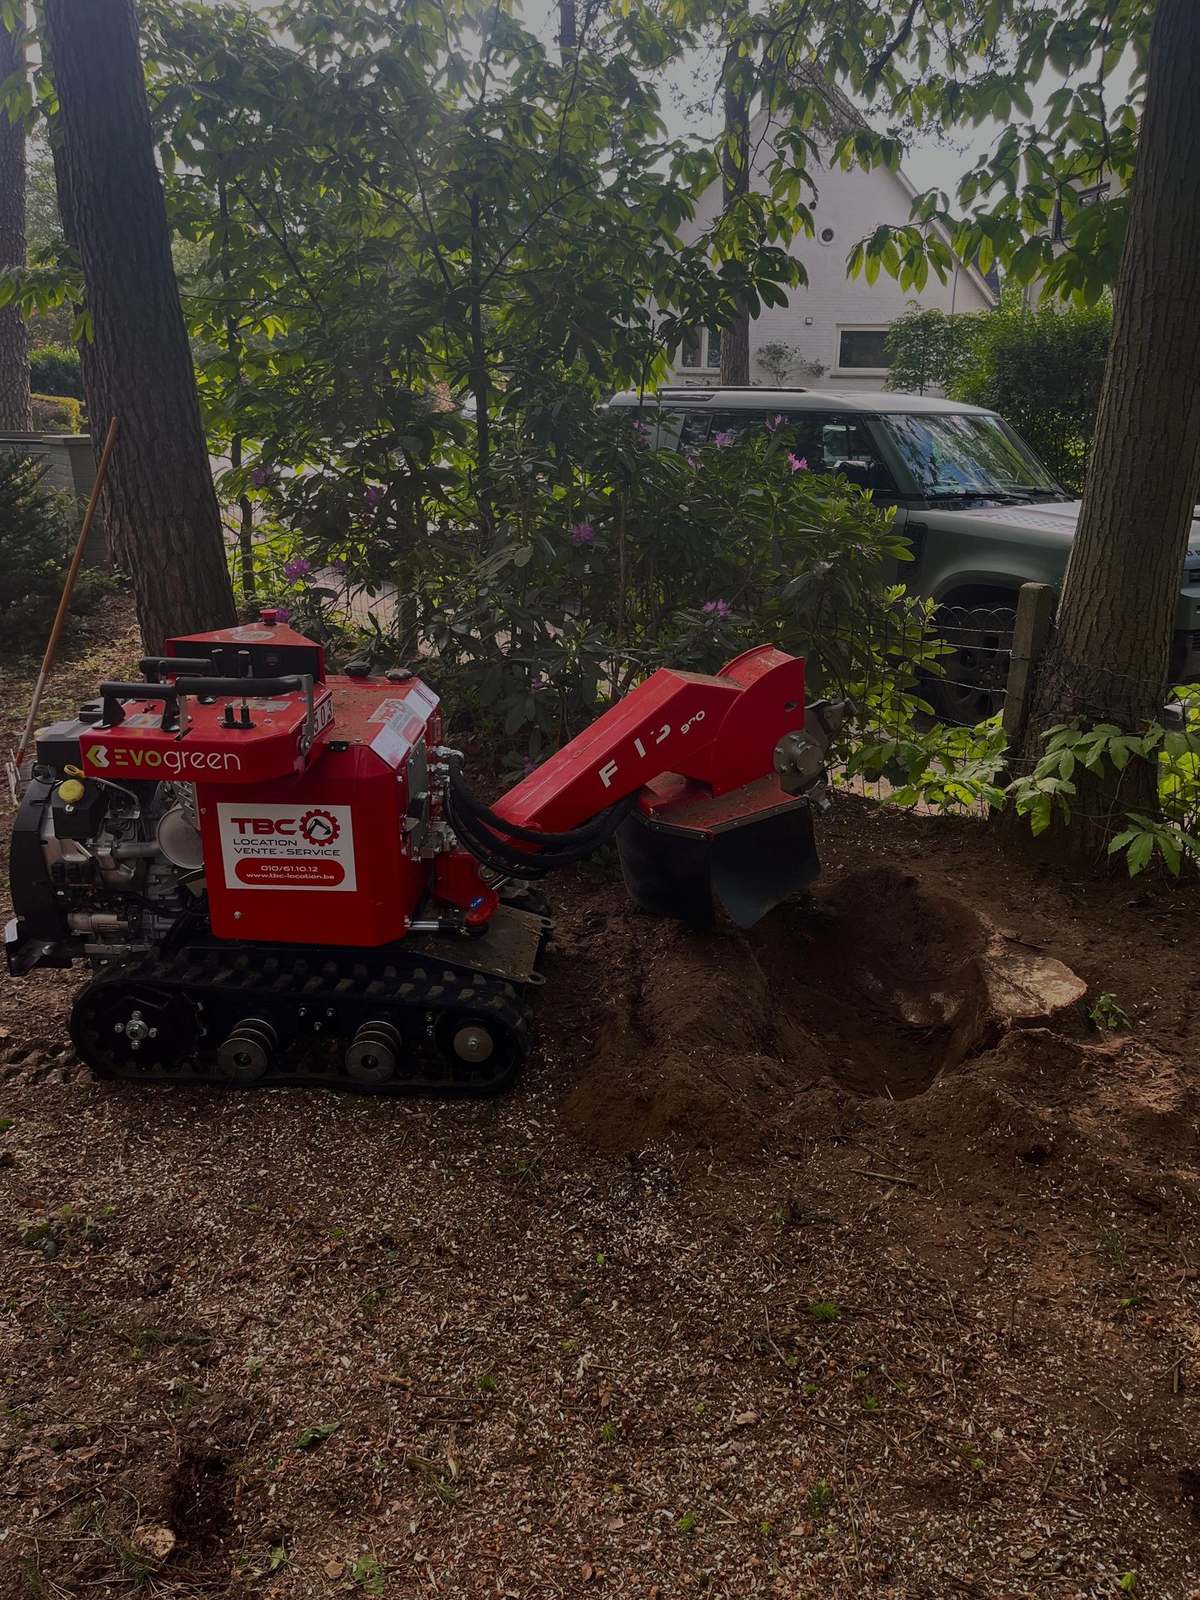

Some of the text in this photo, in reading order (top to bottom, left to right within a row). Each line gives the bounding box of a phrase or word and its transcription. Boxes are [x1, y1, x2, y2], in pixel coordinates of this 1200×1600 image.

[231, 818, 296, 835] TBC
[233, 838, 298, 846] LOCATION
[233, 847, 277, 855] VENTE
[287, 848, 341, 856] SERVICE
[246, 872, 335, 880] www.tbc-location.be
